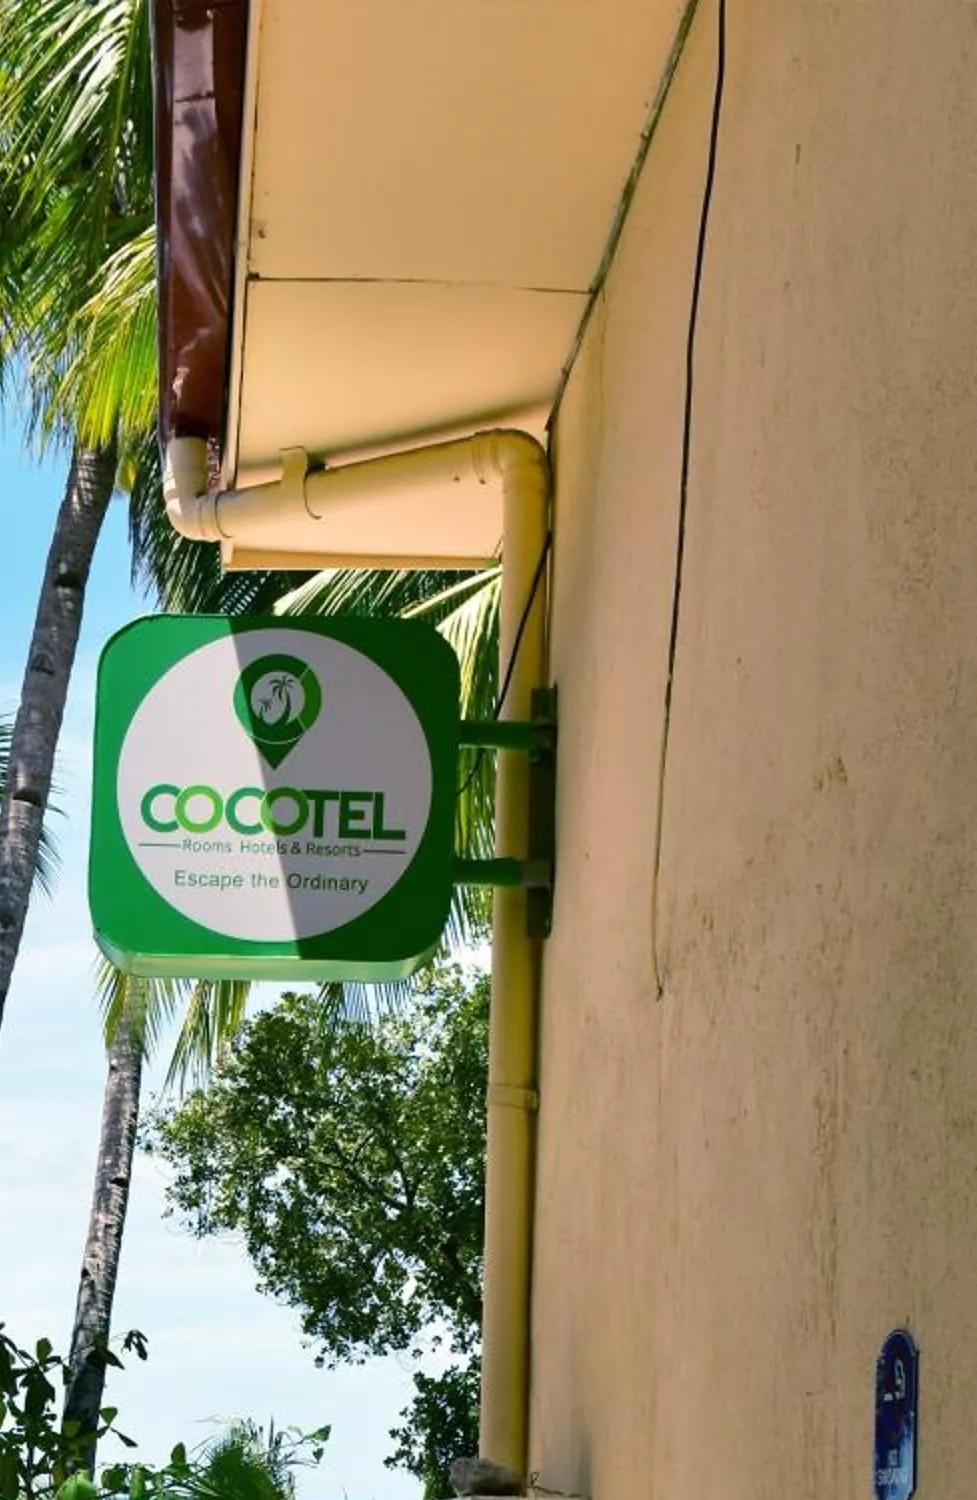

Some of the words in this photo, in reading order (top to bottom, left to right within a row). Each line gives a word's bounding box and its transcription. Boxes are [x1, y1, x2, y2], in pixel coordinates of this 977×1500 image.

[140, 783, 406, 840] COCOTEL
[181, 838, 232, 852] Rooms
[240, 839, 288, 855] Hotels
[290, 841, 301, 855] &
[306, 842, 361, 857] Resorts
[174, 869, 244, 891] Escape
[251, 872, 280, 889] the
[287, 873, 368, 895] Ordinary
